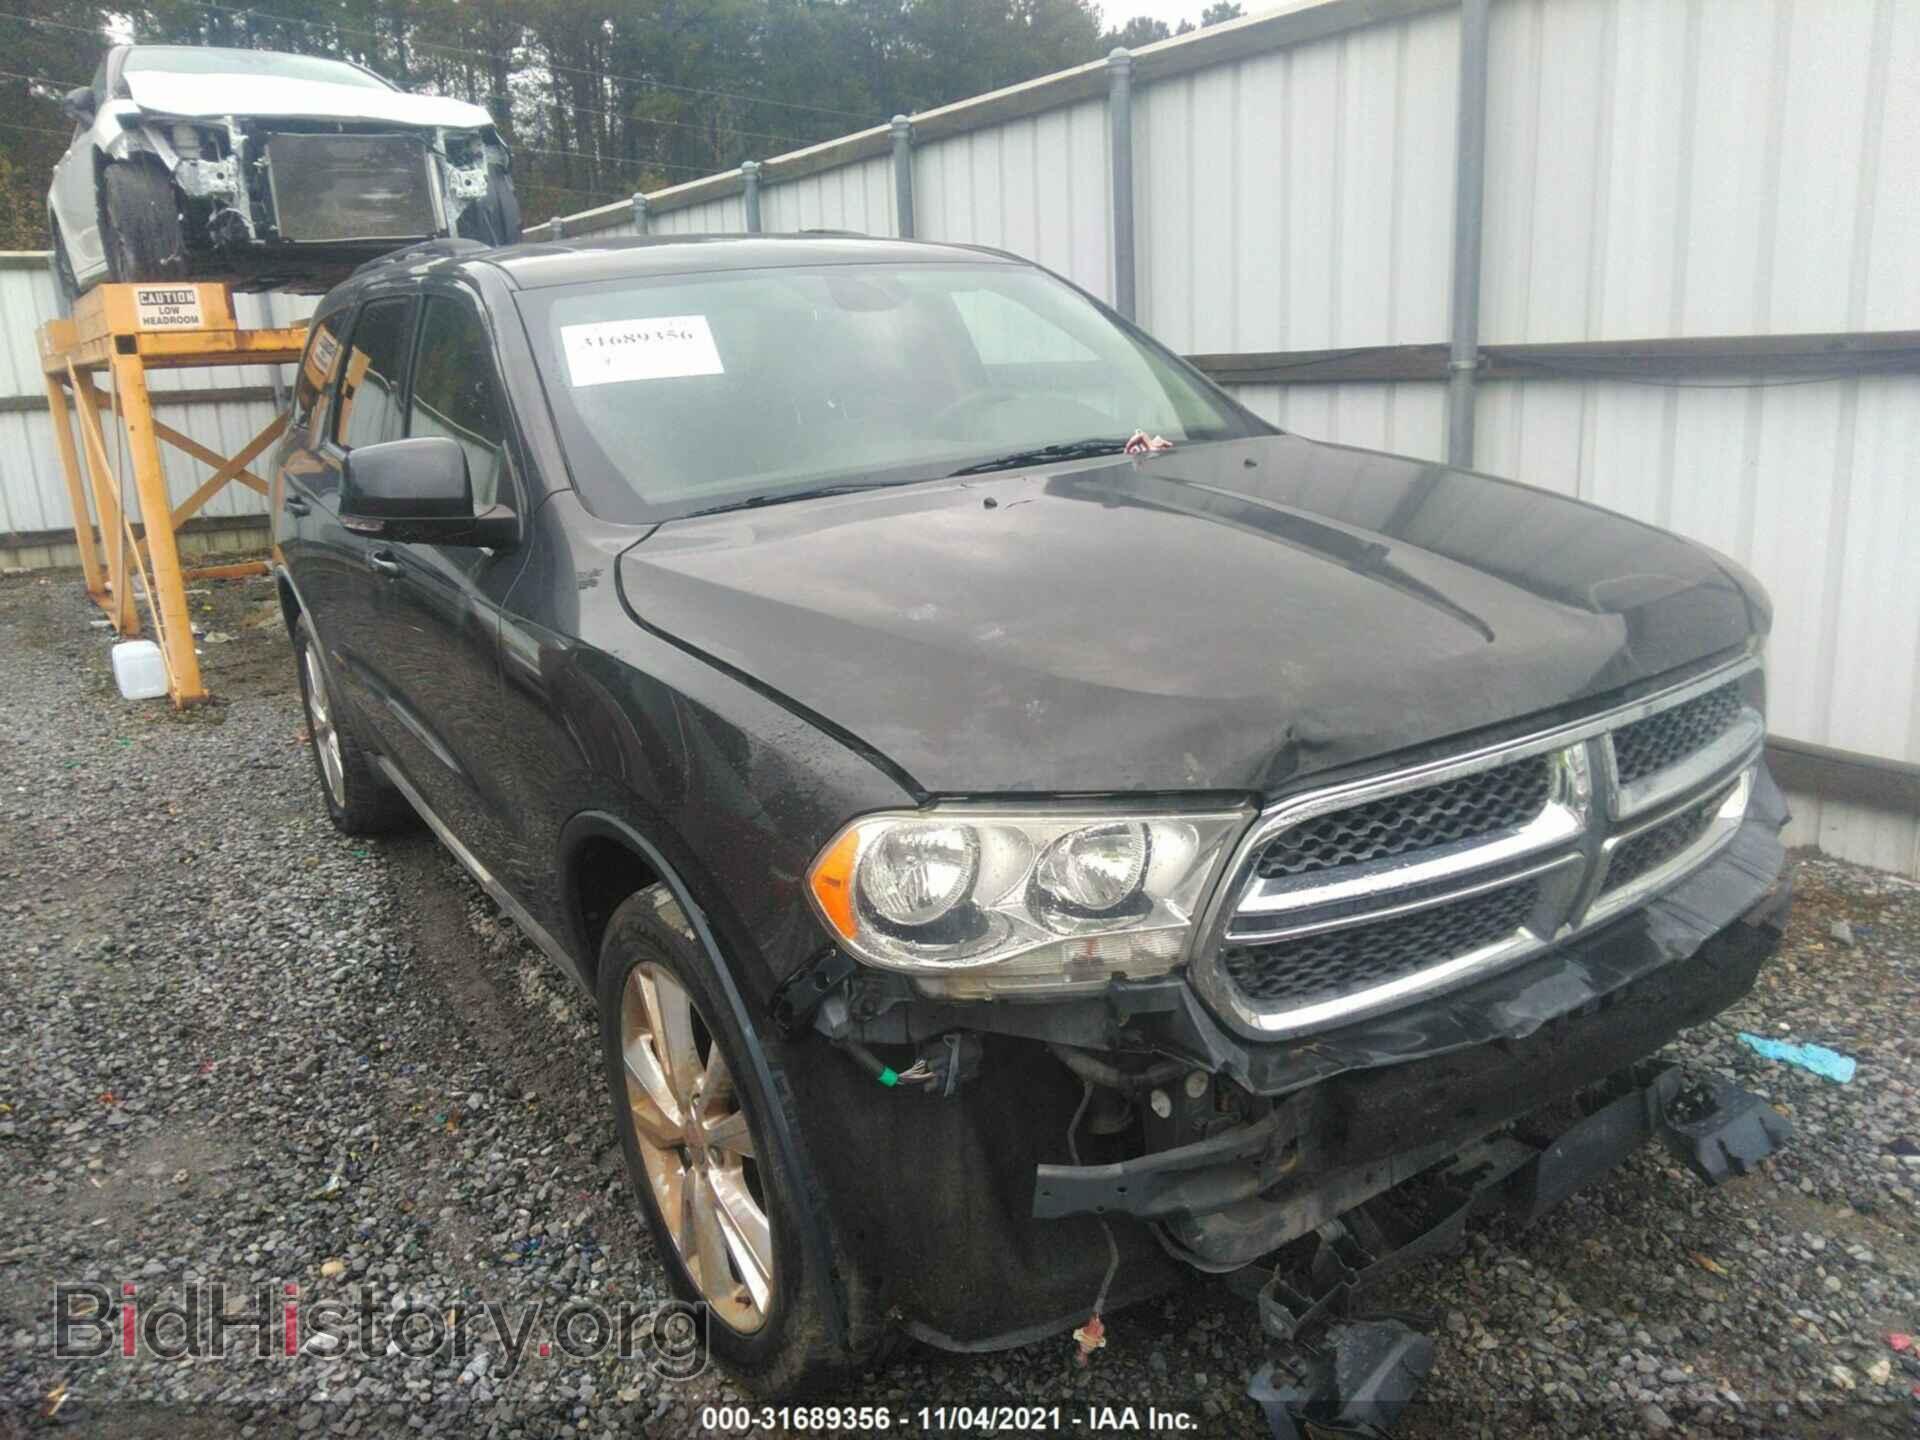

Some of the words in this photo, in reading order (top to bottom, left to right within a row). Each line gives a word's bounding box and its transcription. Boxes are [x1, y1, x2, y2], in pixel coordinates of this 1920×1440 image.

[139, 290, 195, 305] CAUTION
[158, 306, 180, 315] LOW
[143, 315, 199, 325] HEADROOM
